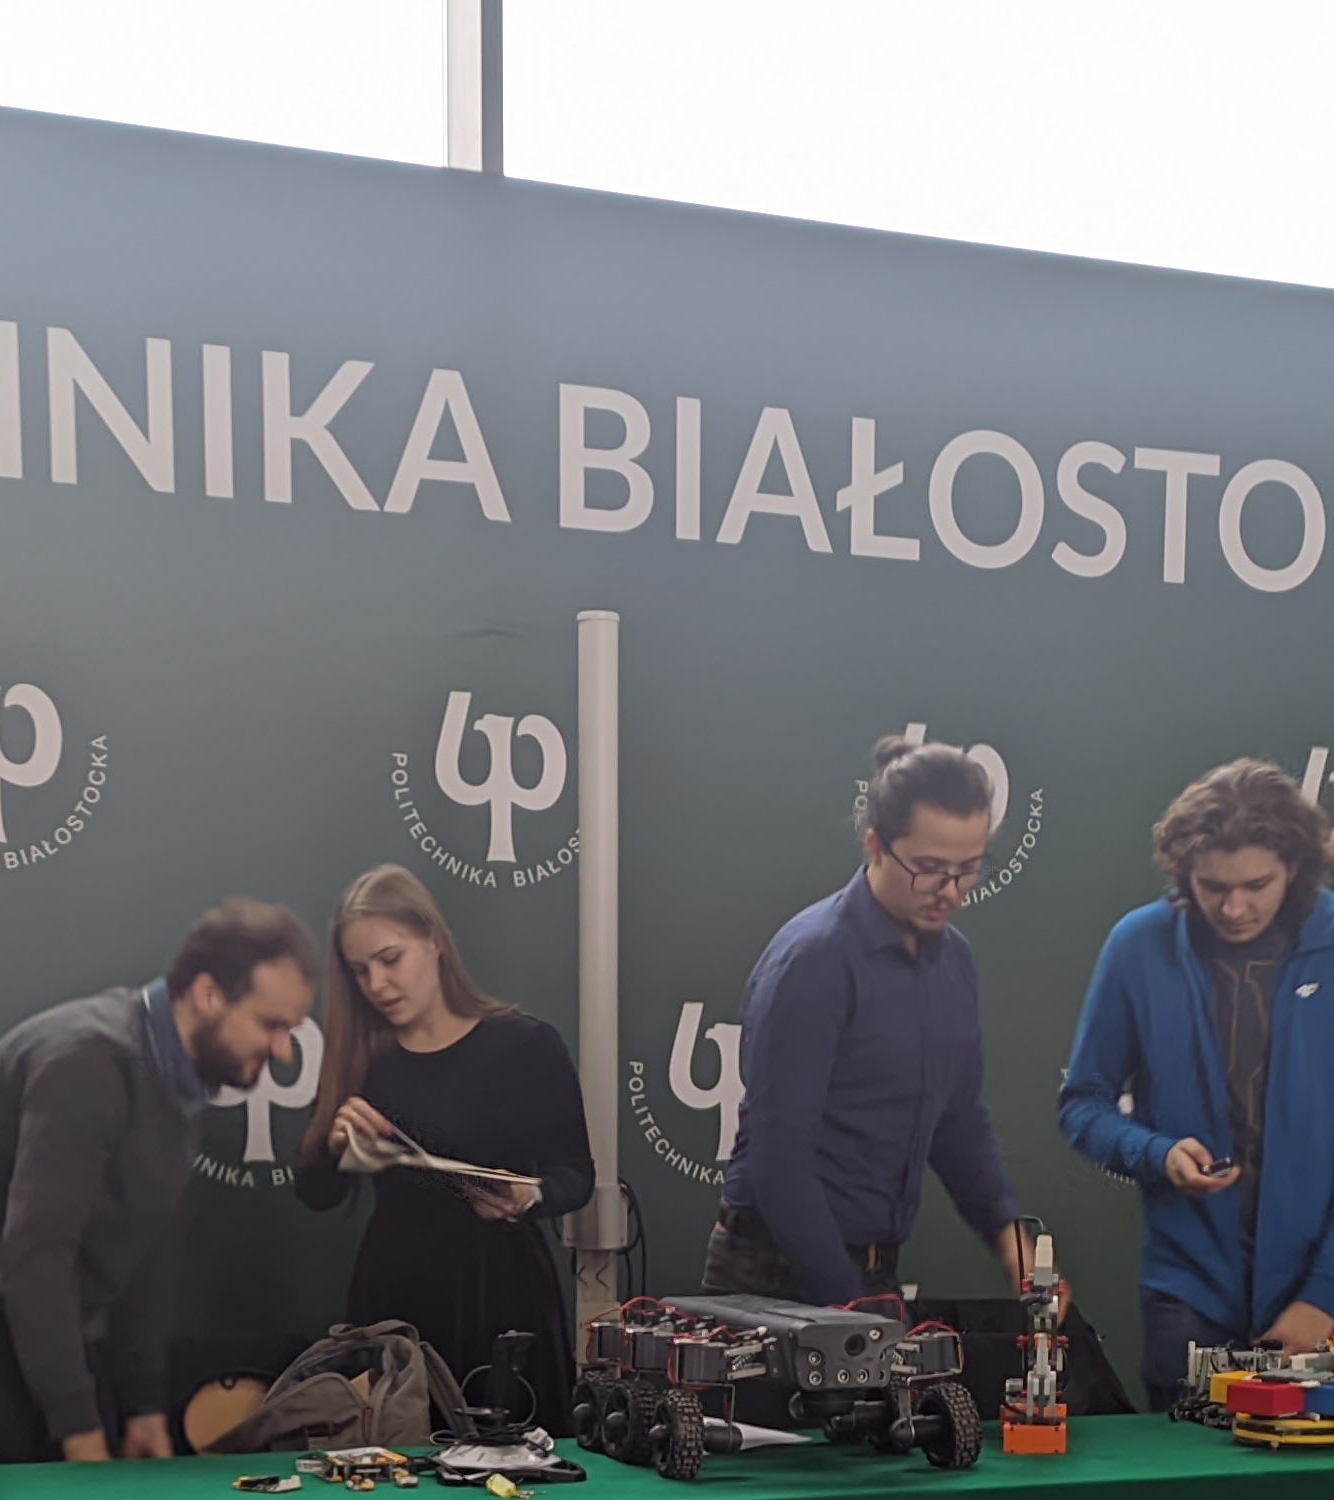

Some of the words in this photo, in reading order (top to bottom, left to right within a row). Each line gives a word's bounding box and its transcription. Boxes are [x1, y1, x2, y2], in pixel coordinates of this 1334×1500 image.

[3, 734, 108, 870] BIAŁOSTOCKA
[391, 752, 497, 888] POLITECHNIKA
[628, 1060, 726, 1185] POLITECHNIKA
